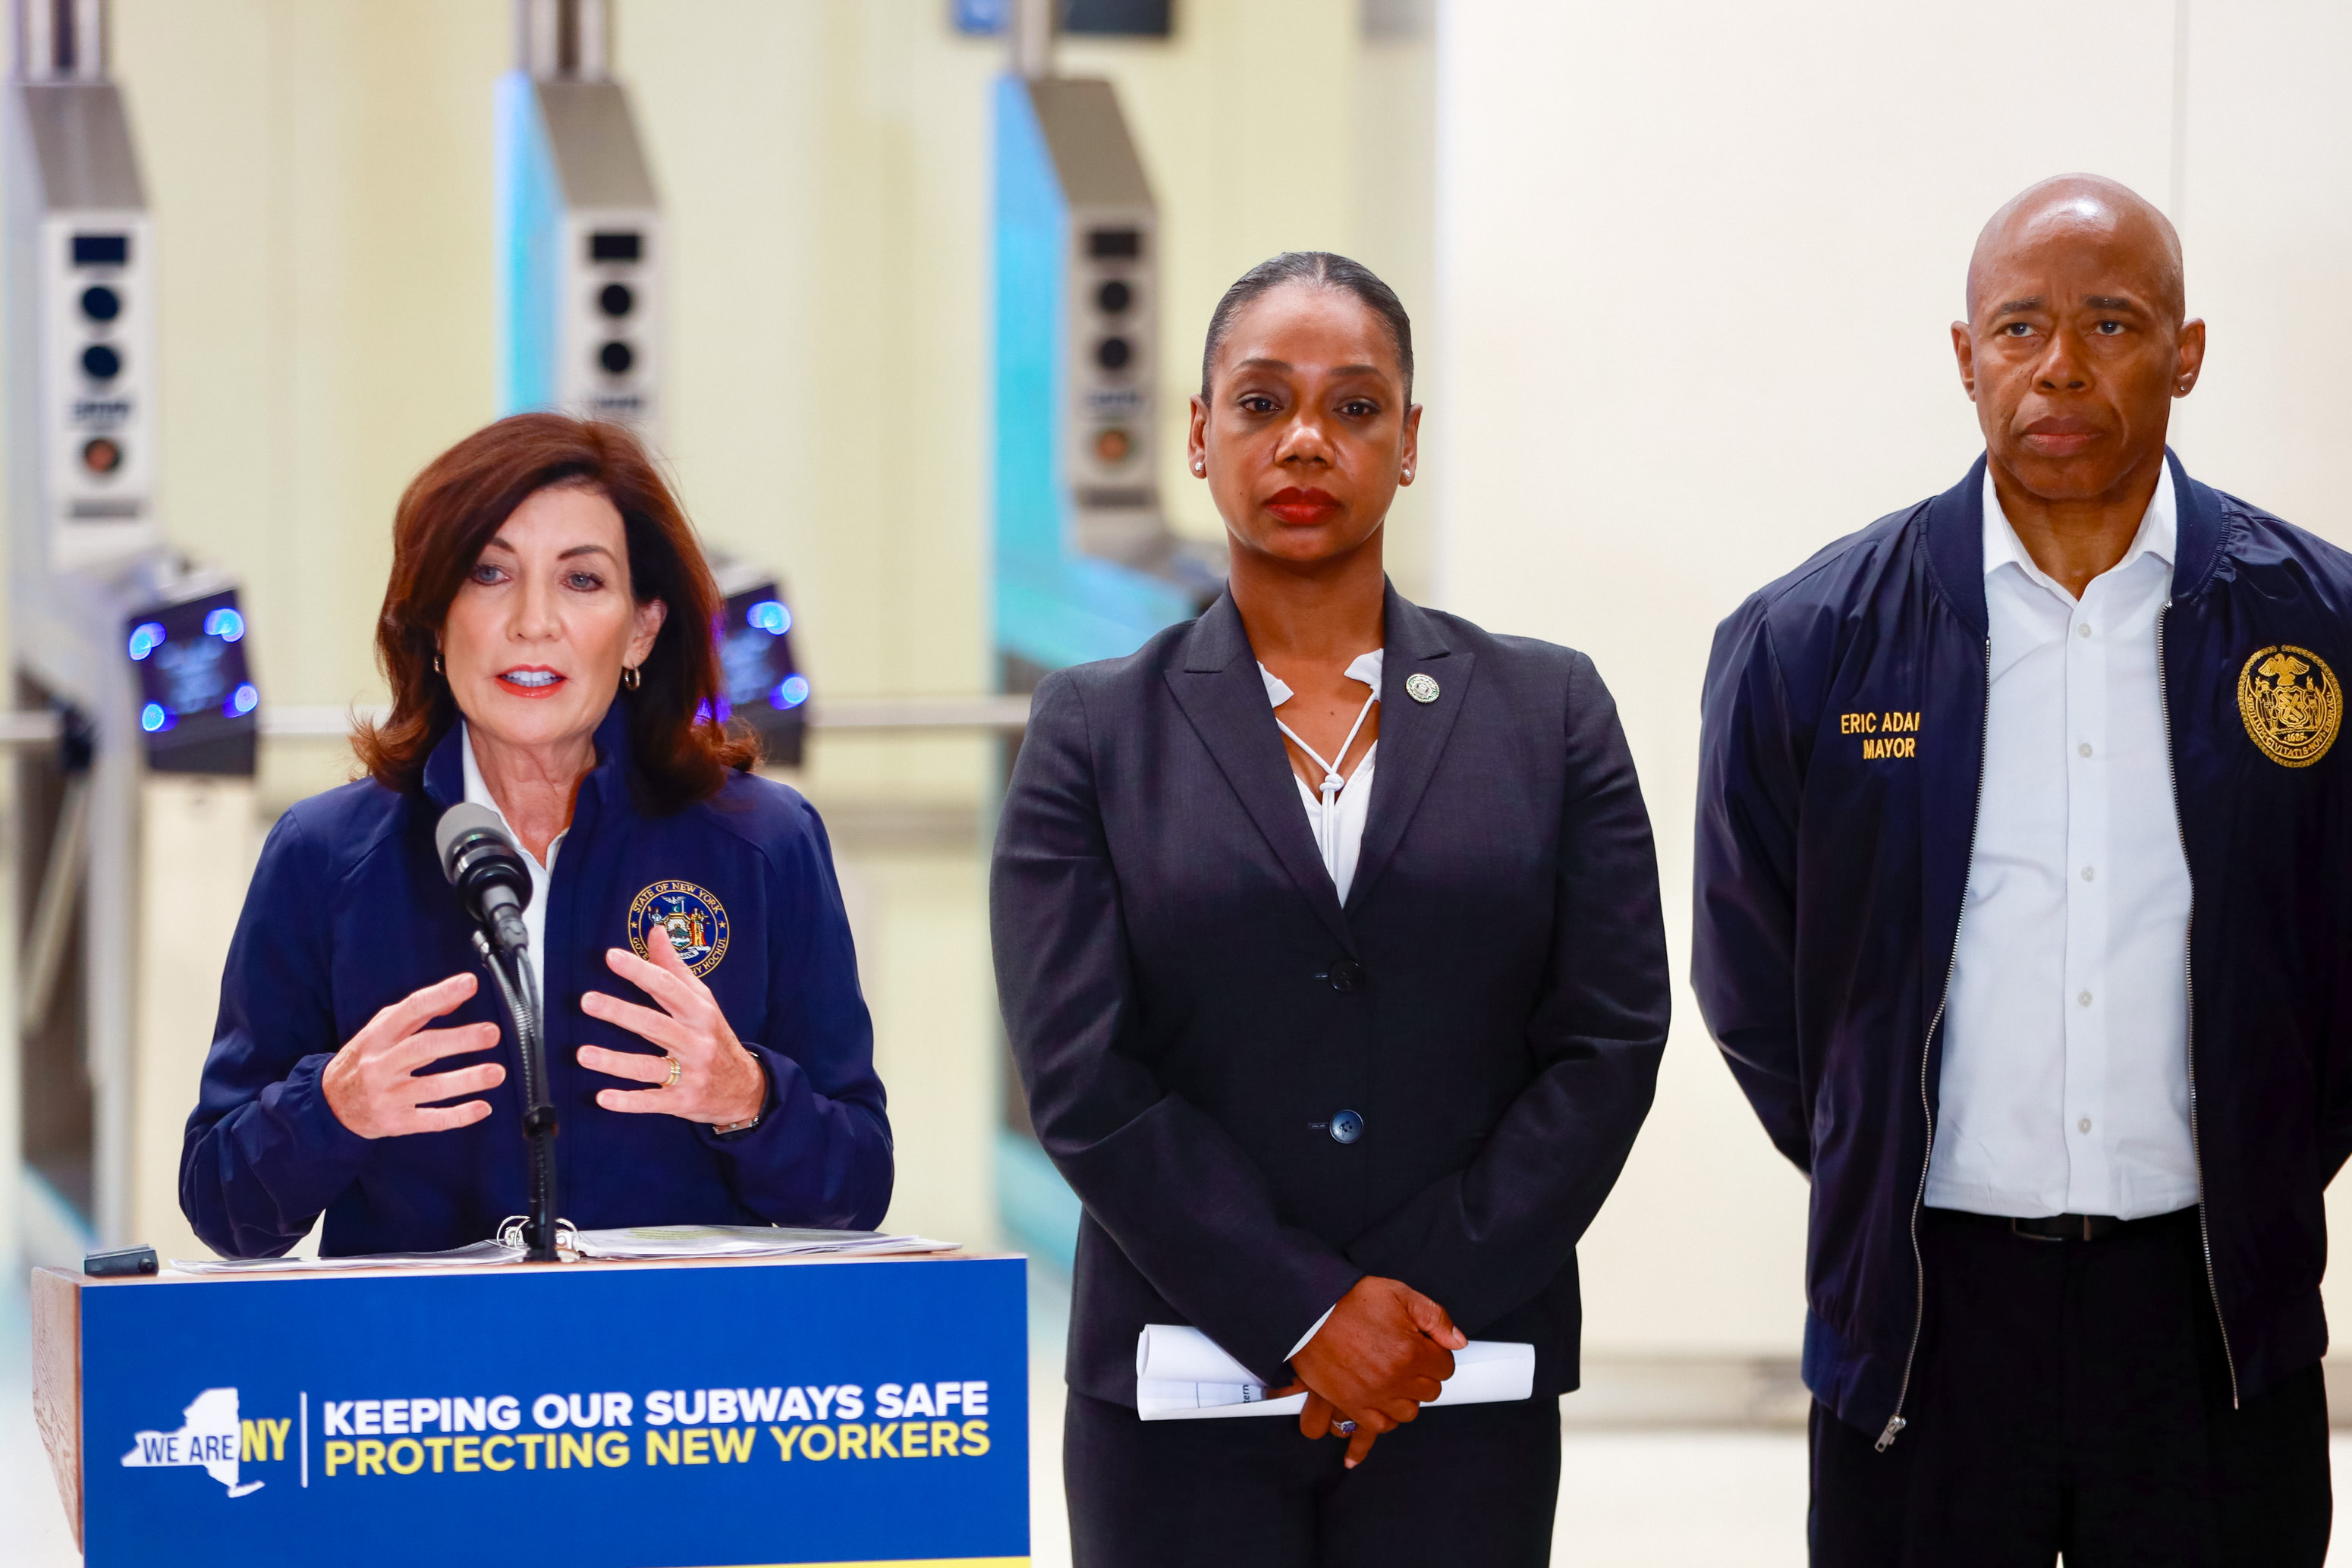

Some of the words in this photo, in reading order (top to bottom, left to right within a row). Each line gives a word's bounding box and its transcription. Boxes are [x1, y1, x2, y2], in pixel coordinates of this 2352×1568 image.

[1841, 712, 1877, 734] ERIC
[2266, 737, 2309, 756] CIVITATIS
[2308, 731, 2326, 751] NOVI
[2323, 693, 2334, 733] EBORACI
[1863, 737, 1916, 759] MAYOR
[633, 888, 656, 913] STATE
[655, 882, 669, 892] OF
[671, 882, 696, 893] NEW
[698, 890, 722, 915] YORK
[702, 937, 727, 970] HOCHUL
[324, 1396, 521, 1436] KEEPING
[533, 1391, 633, 1429] OUR
[645, 1384, 865, 1426] SUBWAYS
[876, 1381, 989, 1419] SAFE
[143, 1437, 179, 1463] WE
[190, 1435, 234, 1461] ARE
[241, 1418, 291, 1463] NY
[325, 1431, 630, 1477] PROTECTING
[646, 1427, 757, 1466] NEW
[769, 1419, 991, 1462] YORKERS
